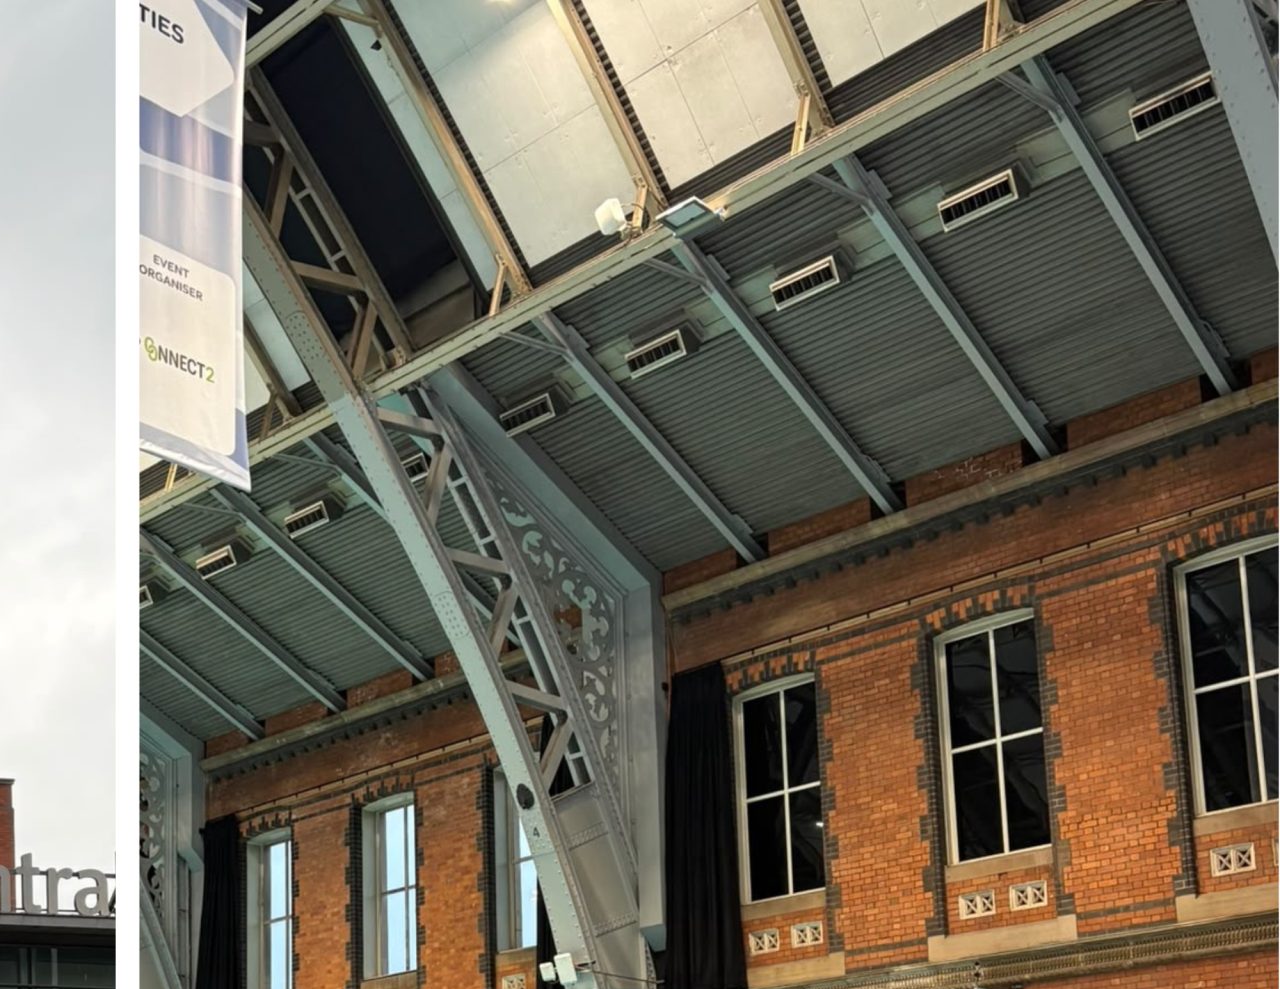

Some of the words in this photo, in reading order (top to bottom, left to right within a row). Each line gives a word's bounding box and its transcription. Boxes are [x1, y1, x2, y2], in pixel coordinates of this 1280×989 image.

[139, 3, 184, 44] TIES
[139, 264, 203, 301] ORGANISER
[153, 254, 189, 278] EVENT
